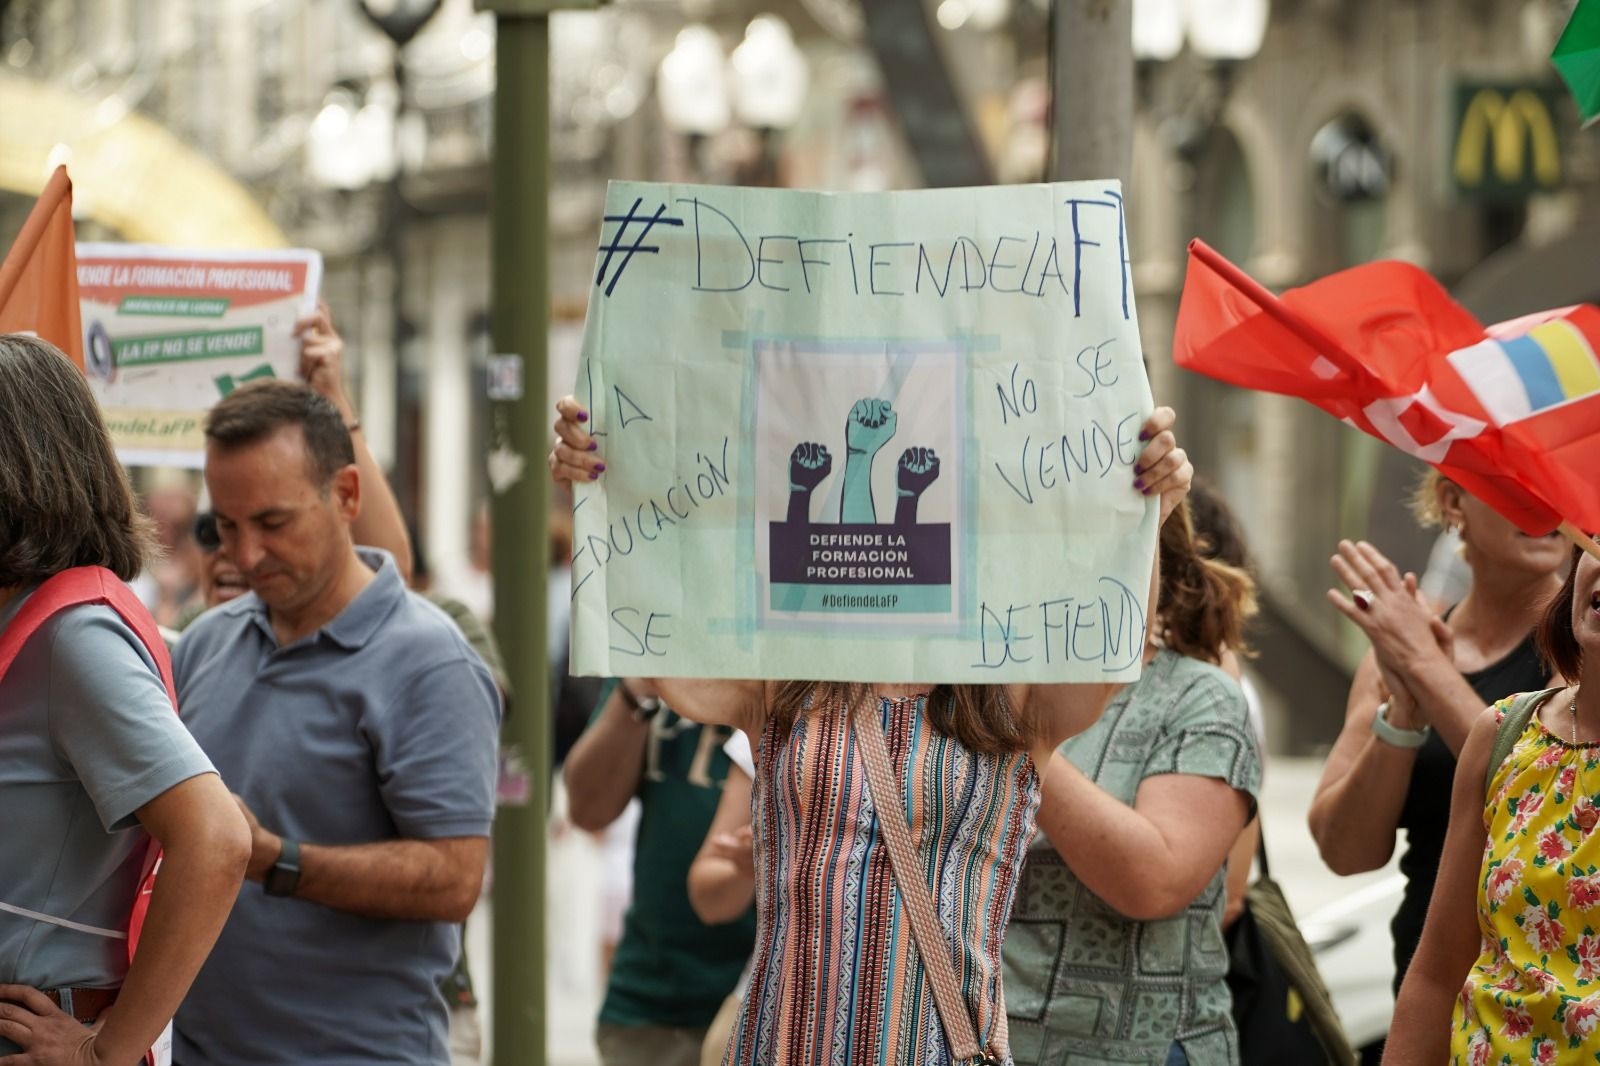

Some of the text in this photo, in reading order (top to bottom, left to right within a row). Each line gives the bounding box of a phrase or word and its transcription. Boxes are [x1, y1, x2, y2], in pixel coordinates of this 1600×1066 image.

[112, 266, 129, 288] LA
[130, 263, 206, 290] FORMACIÓN
[206, 267, 293, 292] PROFESIONAL
[143, 340, 160, 360] FP
[161, 338, 185, 357] NO
[186, 336, 205, 353] SE
[206, 330, 258, 350] VENDE!
[996, 338, 1119, 424] NO SE
[586, 357, 653, 437] LA
[995, 411, 1139, 504] VENDE
[810, 534, 906, 546] DEFIENDE LA
[812, 549, 908, 562] FORMACIÓN
[807, 566, 914, 579] PROFESIONAL
[821, 594, 898, 608] #DefiendeLaFP
[609, 606, 672, 657] SE
